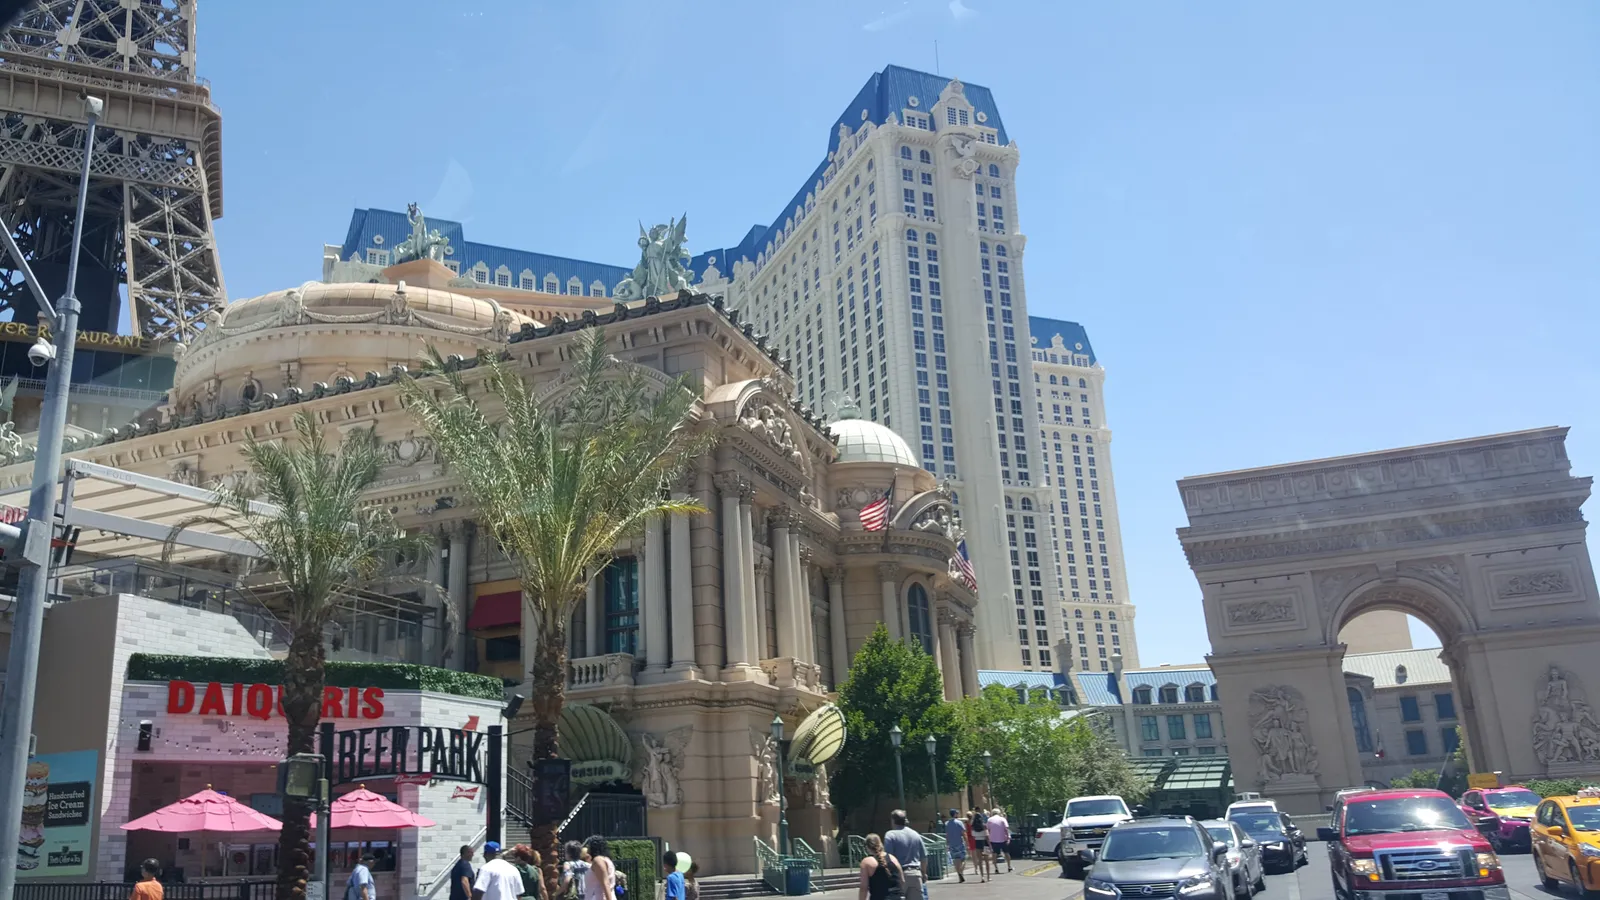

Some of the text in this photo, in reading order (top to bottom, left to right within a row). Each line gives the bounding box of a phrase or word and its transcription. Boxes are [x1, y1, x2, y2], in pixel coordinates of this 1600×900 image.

[0, 321, 144, 349] ER RAURANT
[167, 680, 385, 720] DAIQRIS
[338, 727, 484, 785] BEER PARK
[49, 790, 85, 800] Handcrafted
[48, 800, 84, 810] Ice Cream
[48, 810, 82, 819] Sandwiches
